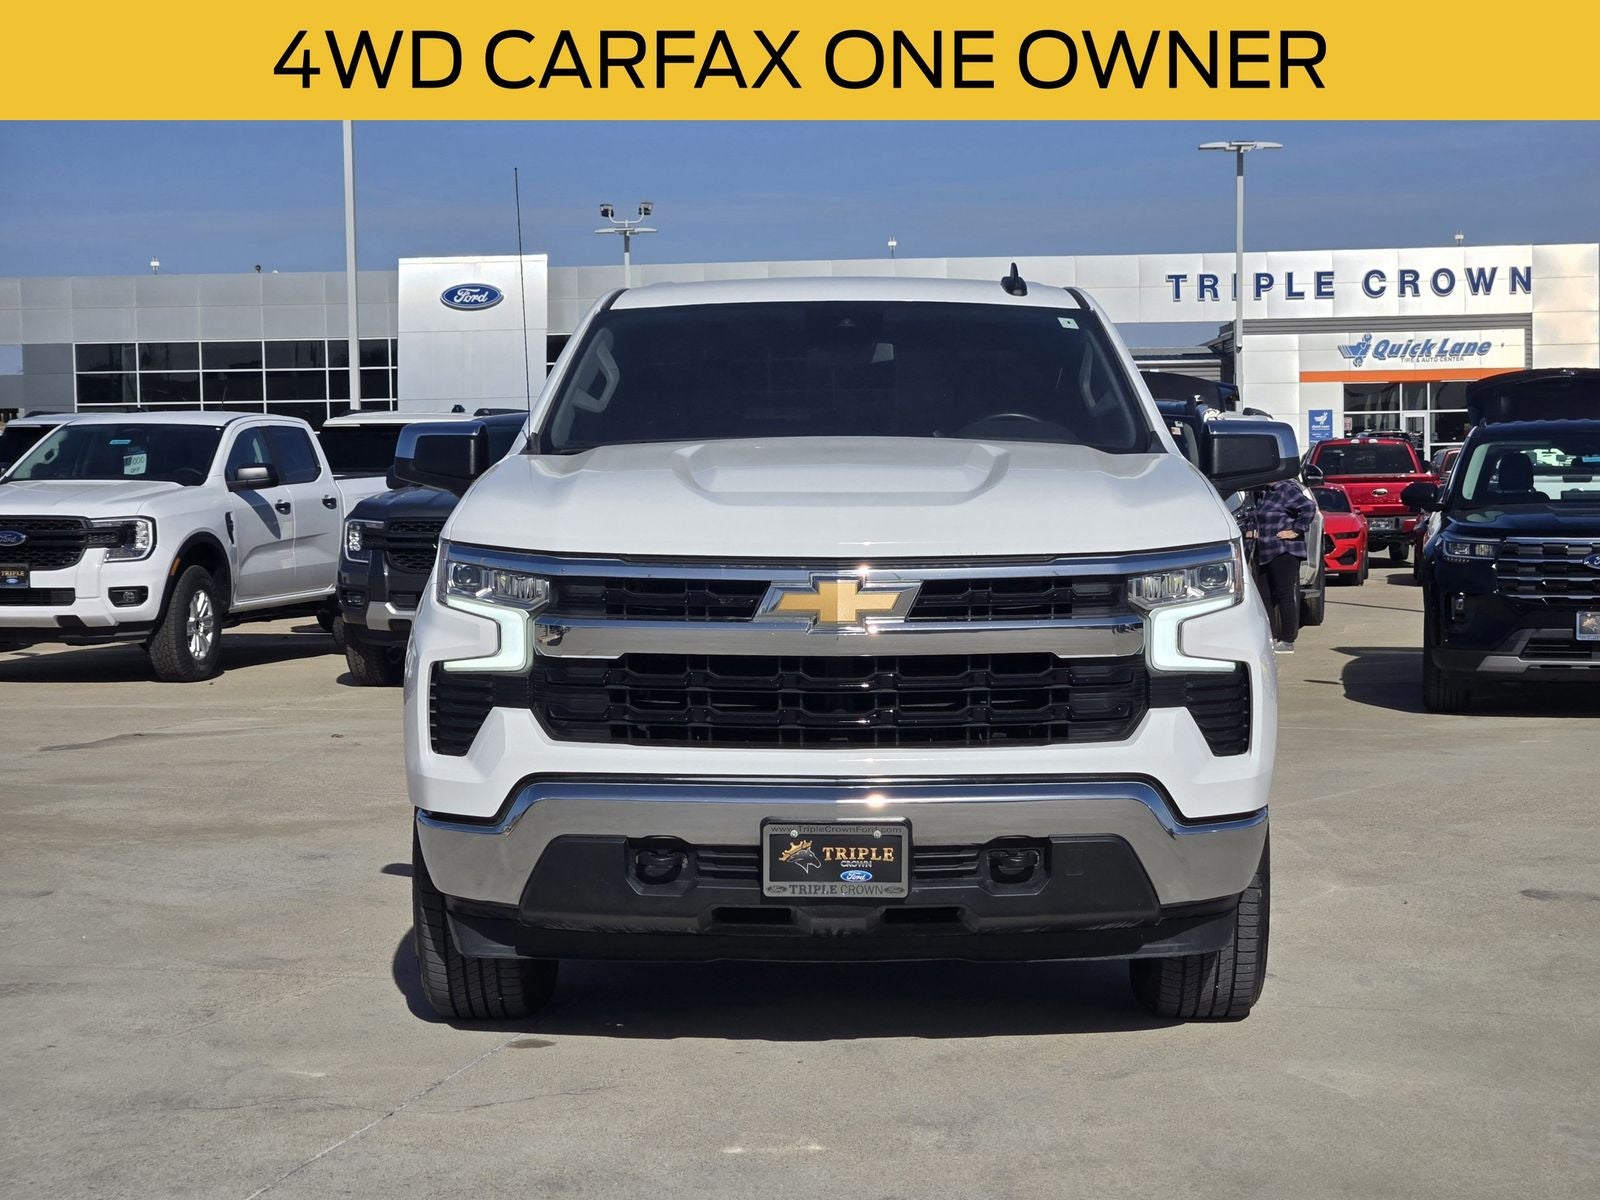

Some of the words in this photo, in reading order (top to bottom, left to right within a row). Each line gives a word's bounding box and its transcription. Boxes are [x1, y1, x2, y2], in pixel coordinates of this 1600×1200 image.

[1362, 266, 1532, 299] CROWN
[453, 288, 490, 303] Ford
[1372, 338, 1436, 360] Quick
[1435, 338, 1493, 357] Lane
[822, 847, 894, 861] TRIPLE
[840, 860, 873, 868] CROWN
[789, 884, 837, 895] TRIPLE
[840, 884, 883, 895] CROWN
